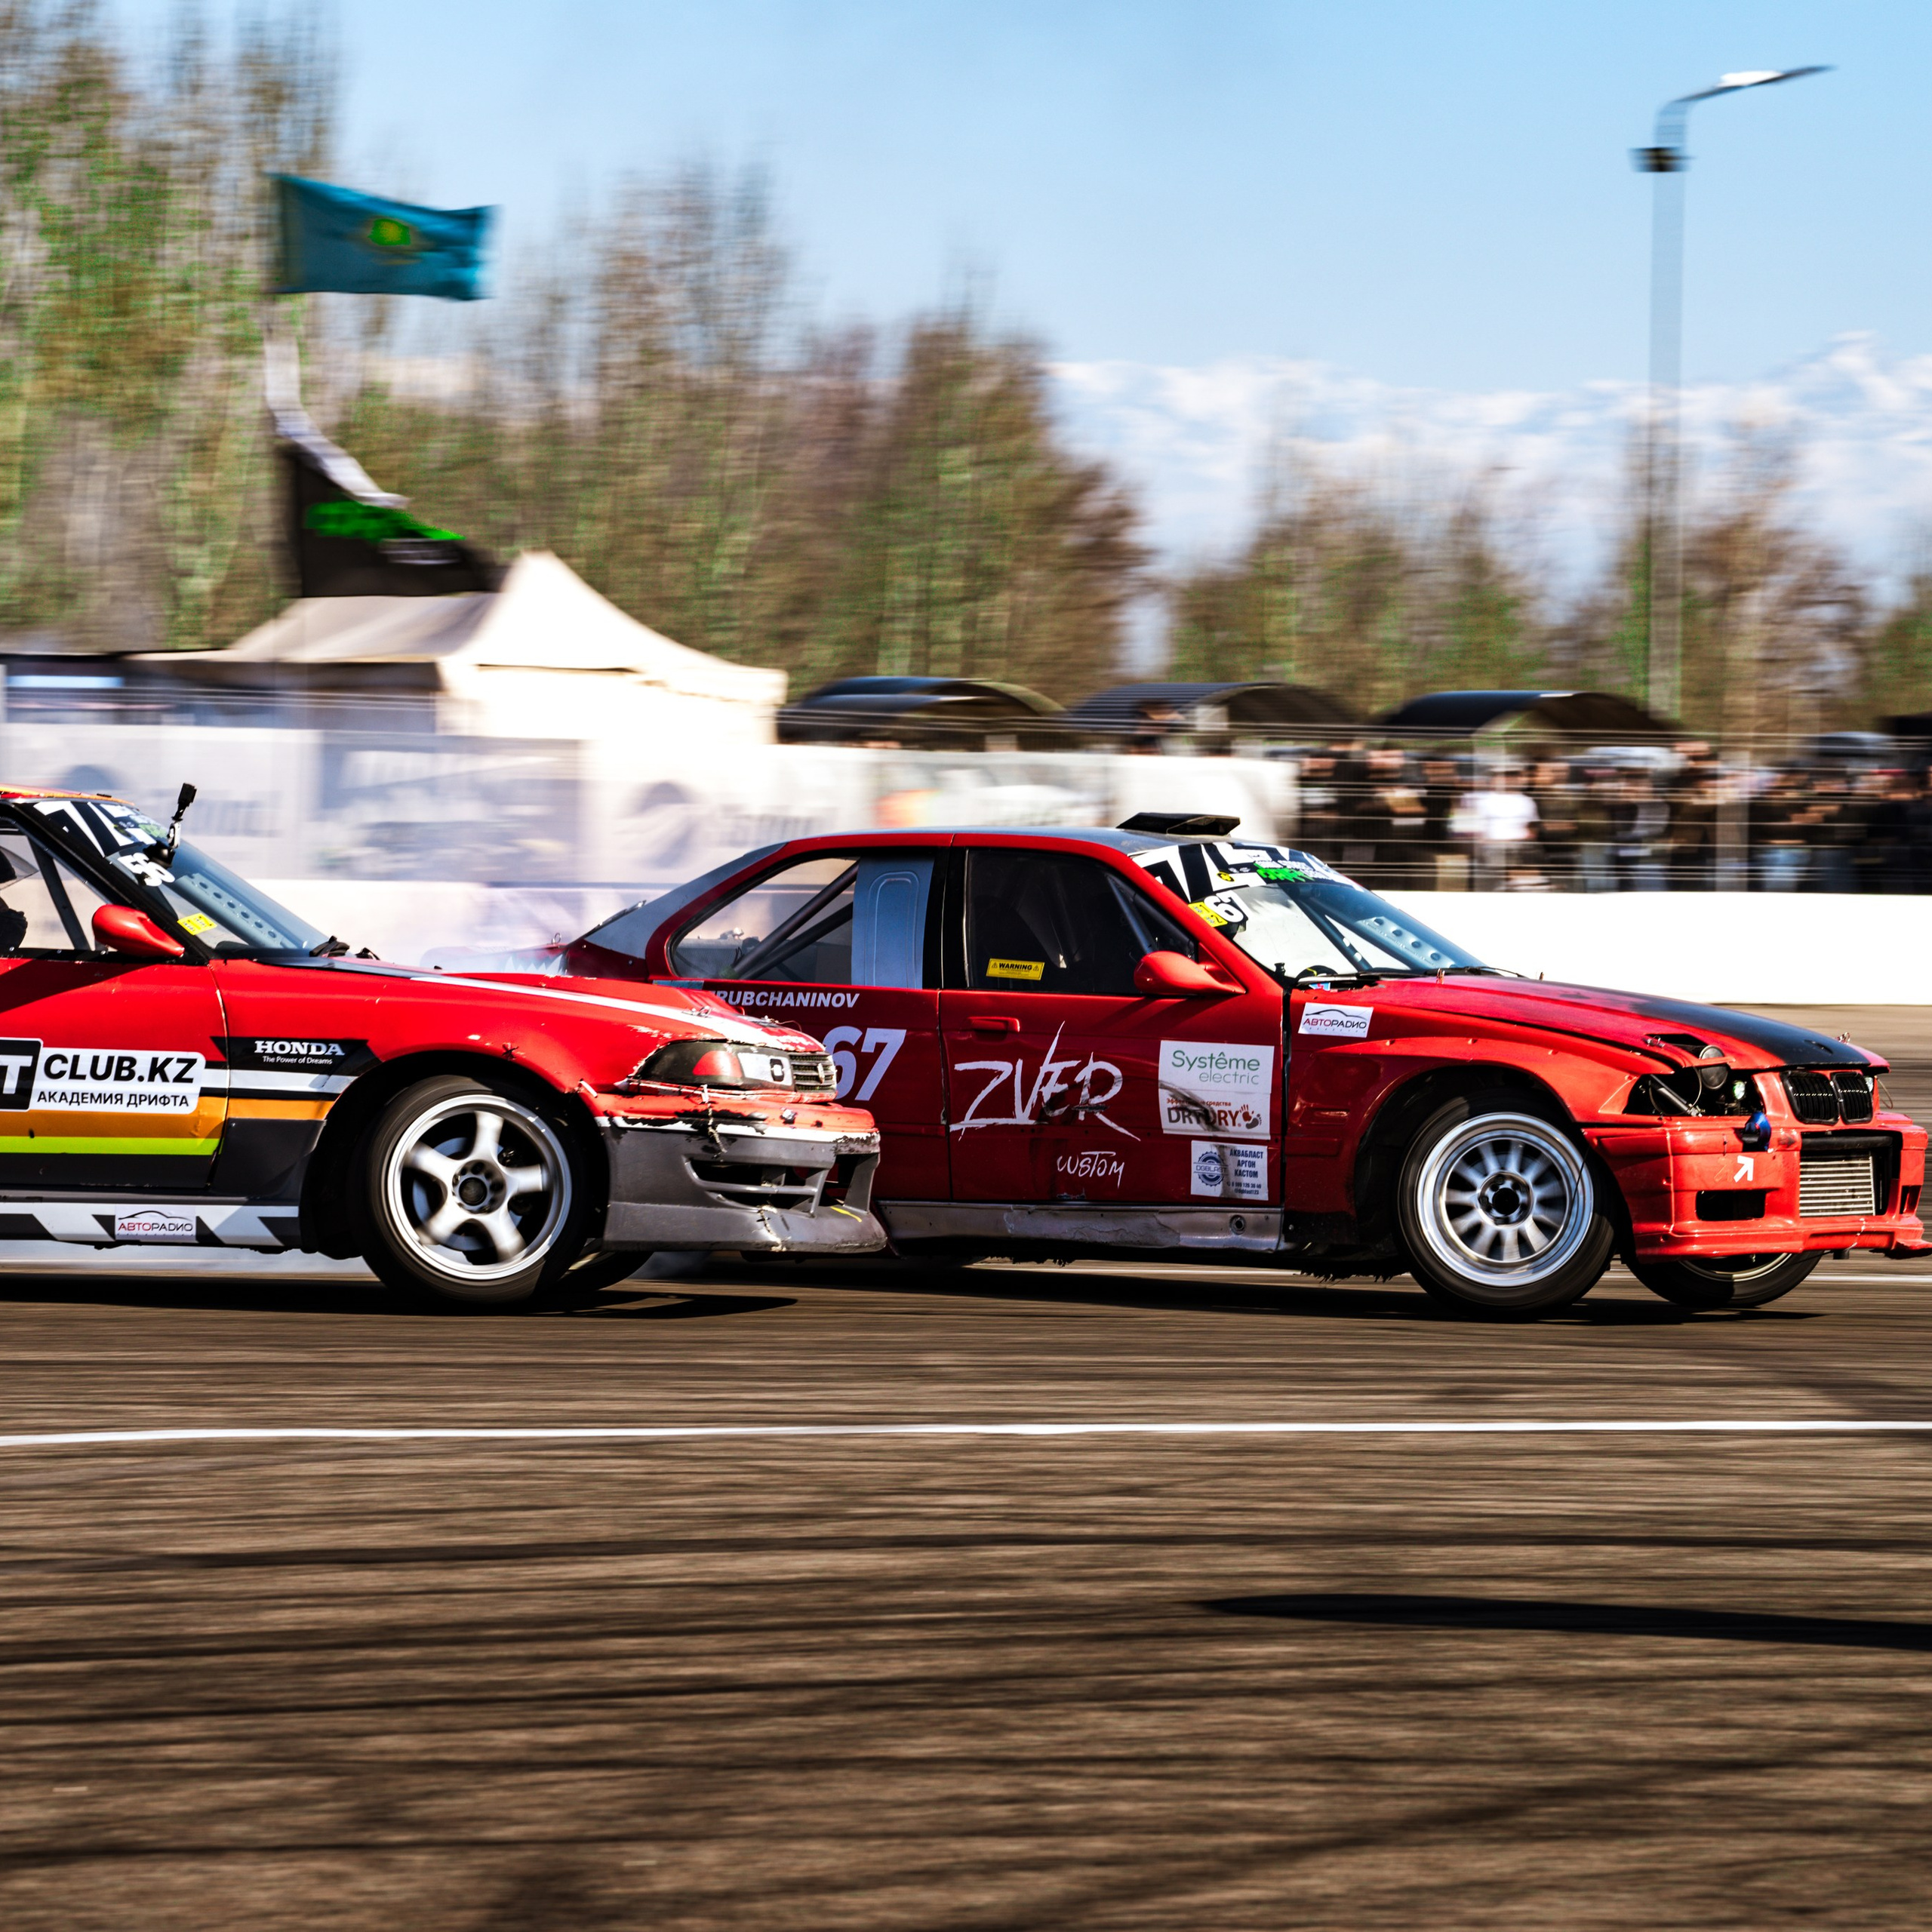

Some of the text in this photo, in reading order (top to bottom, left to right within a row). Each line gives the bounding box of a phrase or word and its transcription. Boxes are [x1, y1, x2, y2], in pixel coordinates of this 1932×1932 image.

[998, 962, 1032, 971] WARNING
[712, 990, 860, 1008] RUBCHANINOV
[254, 1041, 346, 1056] HONDA
[306, 1057, 333, 1065] Dreams
[823, 1026, 906, 1101] 67
[44, 1054, 198, 1084] CLUB.KZ
[949, 1020, 1141, 1142] ZVER
[1198, 1069, 1260, 1085] electric
[37, 1091, 189, 1108] АКАДЕМИЯ ДРИФТА
[1229, 1149, 1264, 1159] АКВАБЛАСТ
[1236, 1159, 1256, 1168] АРГОН
[1234, 1169, 1259, 1178] КАСТОМ
